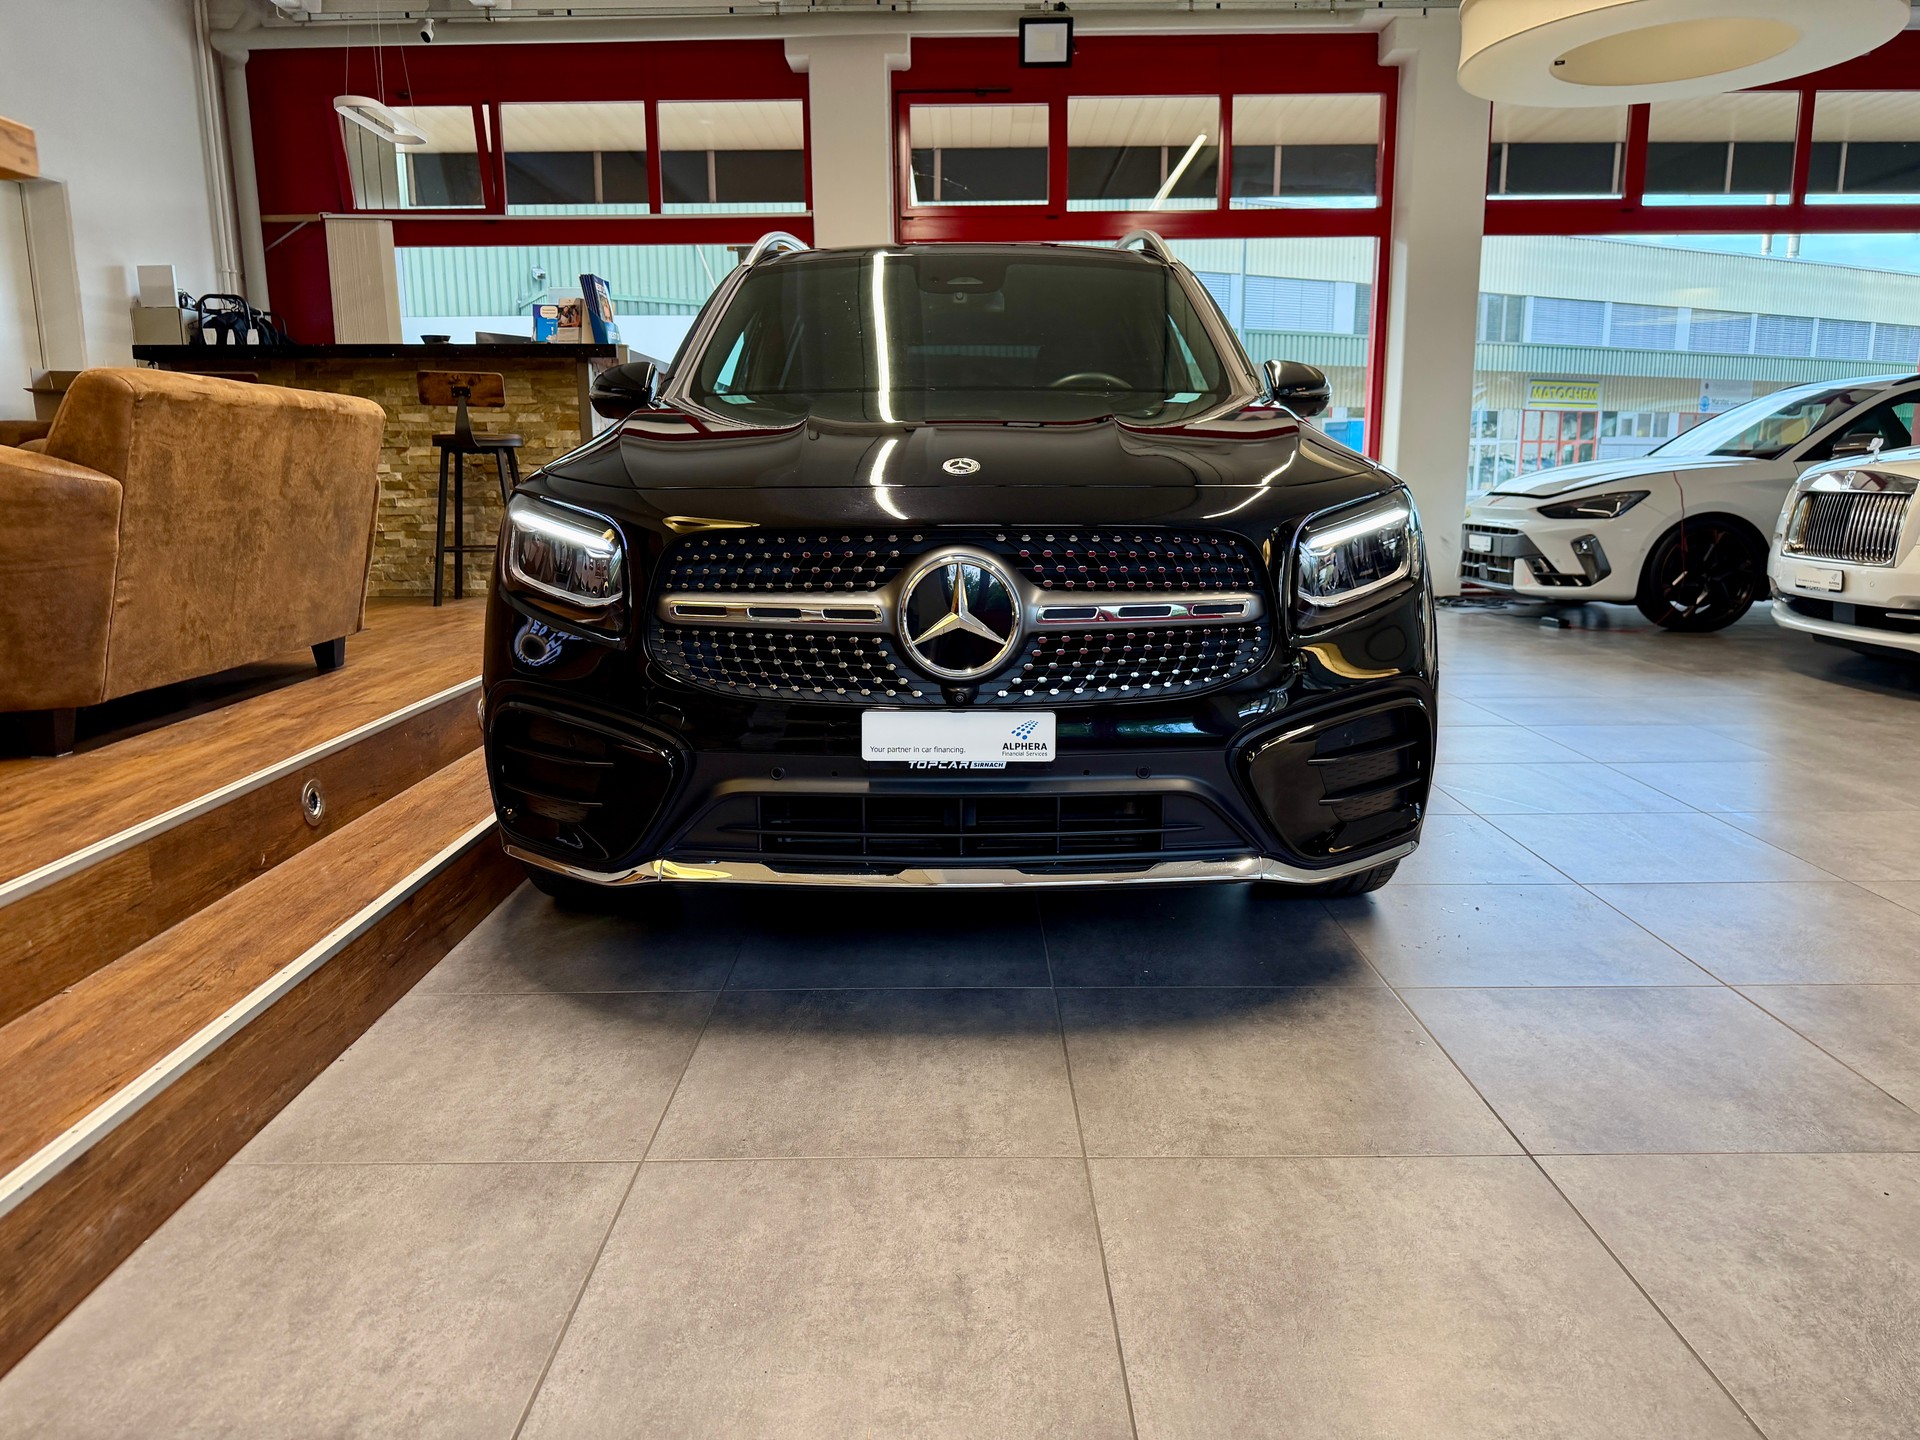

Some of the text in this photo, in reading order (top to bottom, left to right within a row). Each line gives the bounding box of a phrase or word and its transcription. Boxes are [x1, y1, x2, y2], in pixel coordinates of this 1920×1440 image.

[1531, 386, 1598, 400] MATOCHEM
[870, 745, 885, 753] Your
[887, 746, 911, 754] partner
[913, 745, 920, 753] in
[933, 745, 966, 755] financing.
[1002, 742, 1048, 751] ALPHERA
[908, 760, 970, 769] TOPCAR
